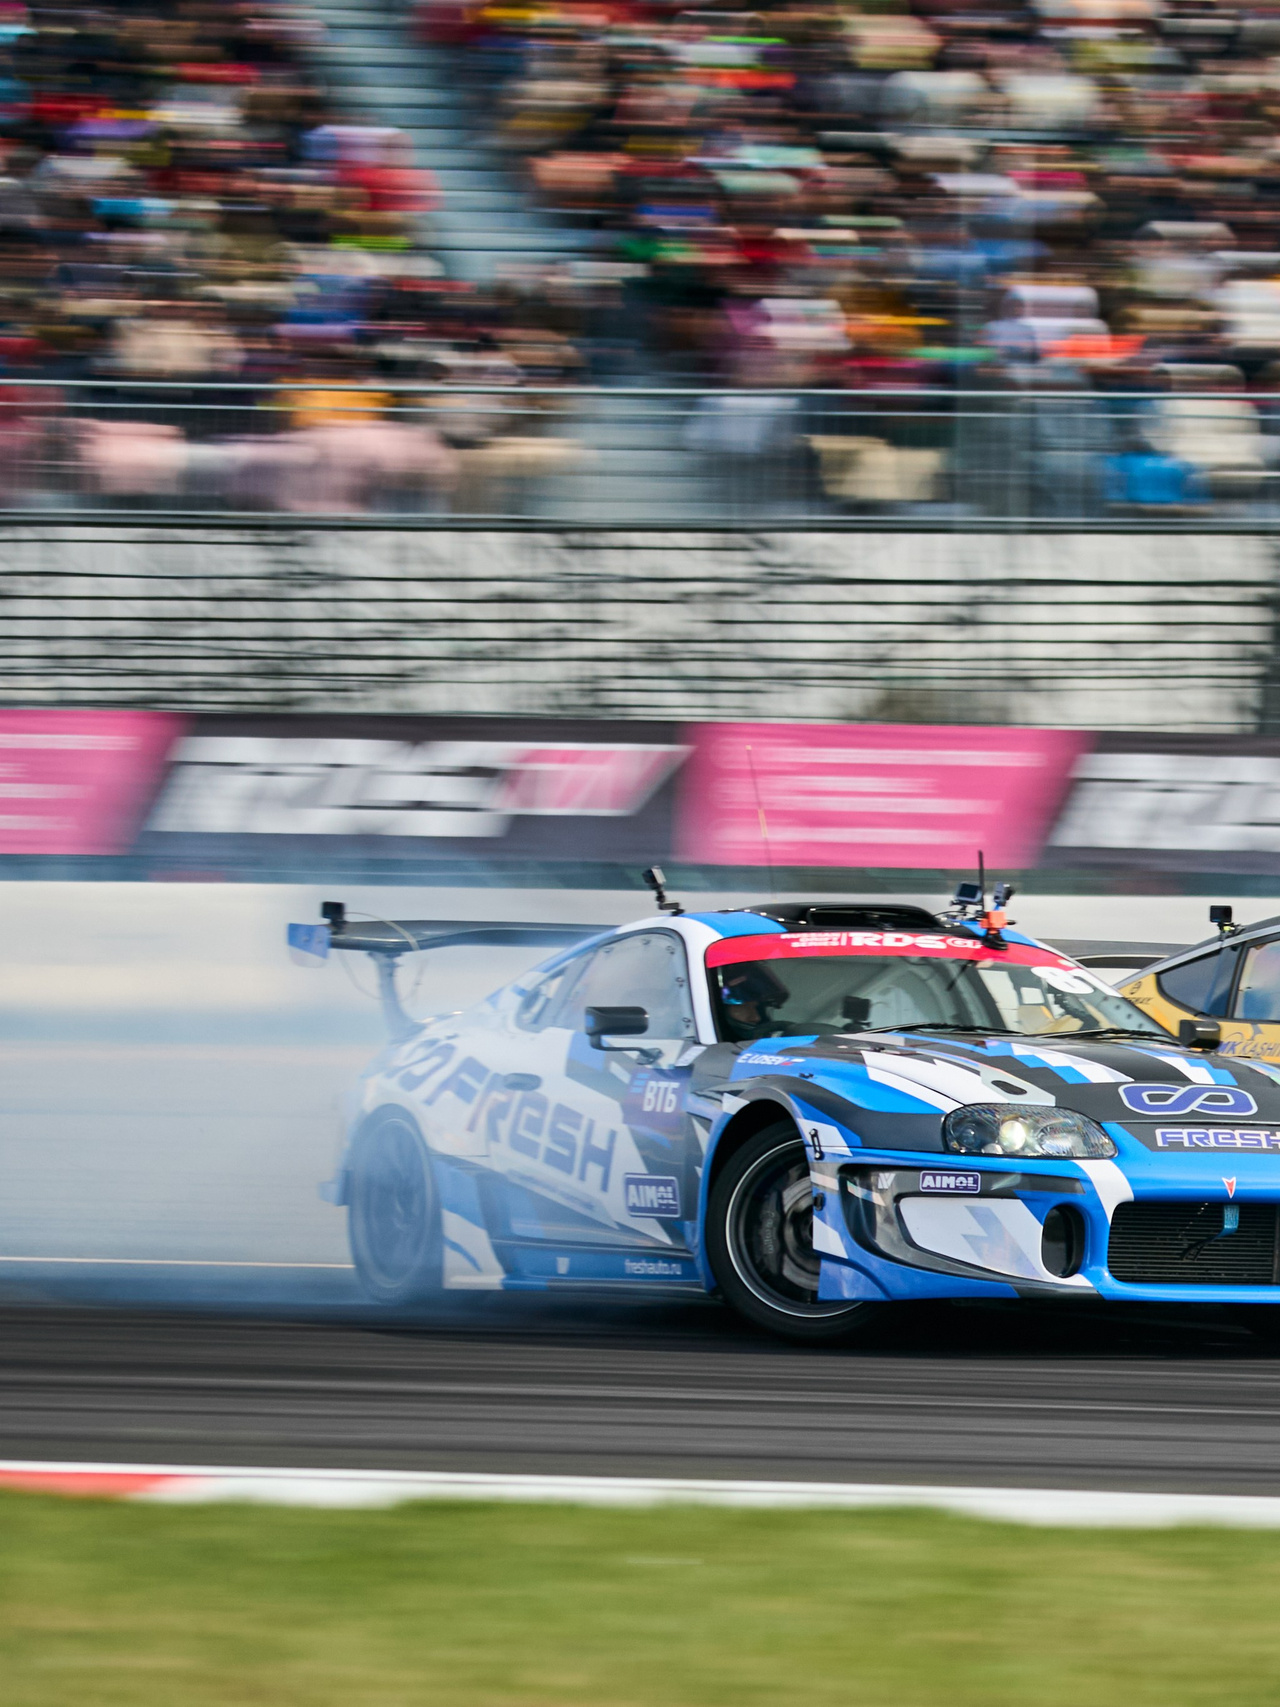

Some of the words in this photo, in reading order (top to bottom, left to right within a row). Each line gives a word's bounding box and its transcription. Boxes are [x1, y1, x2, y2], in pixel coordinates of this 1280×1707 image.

[850, 932, 947, 949] RDS
[642, 1080, 680, 1114] ВТБ
[921, 1175, 978, 1189] AIMOL
